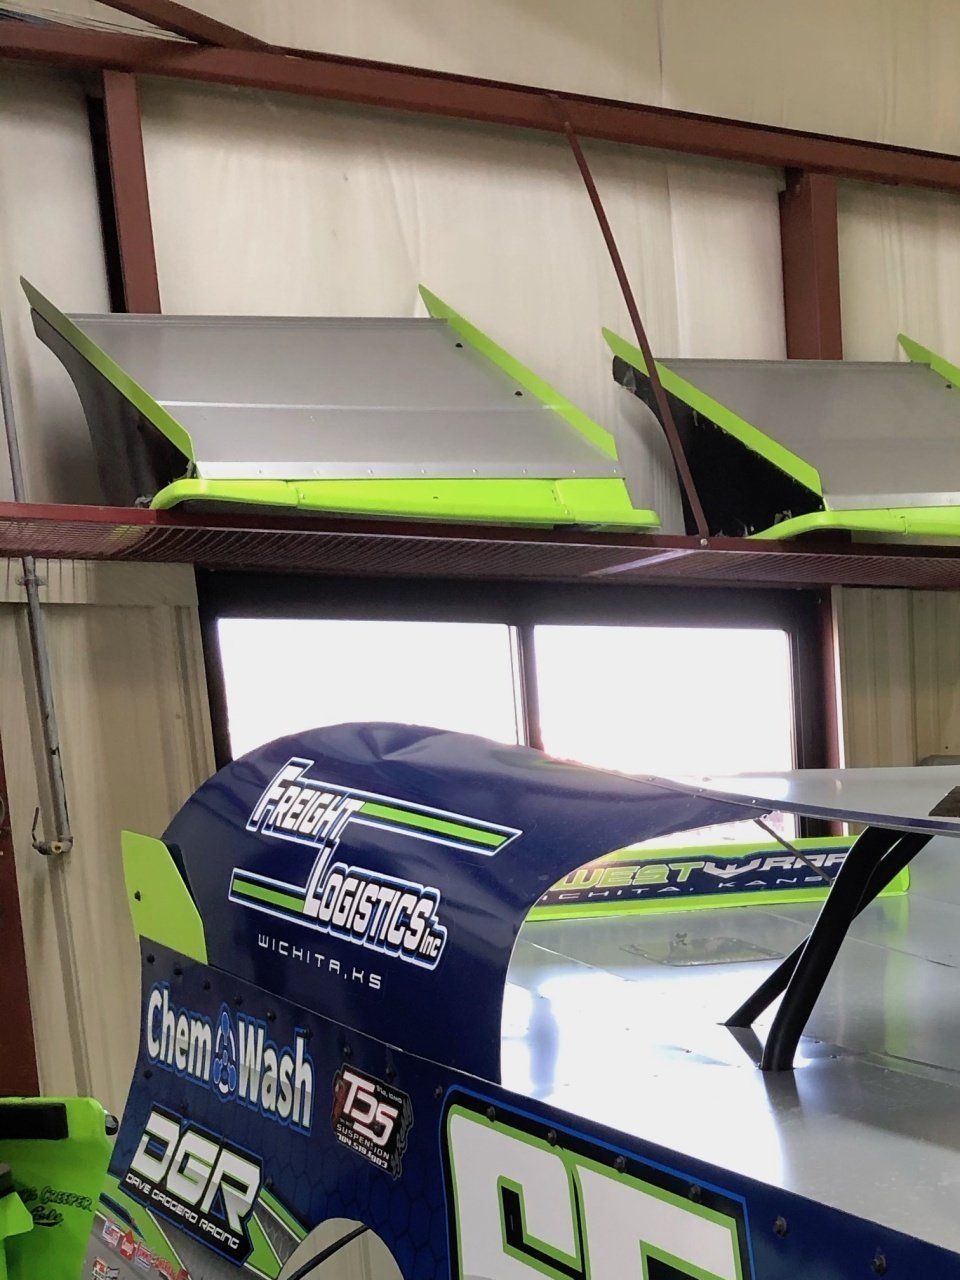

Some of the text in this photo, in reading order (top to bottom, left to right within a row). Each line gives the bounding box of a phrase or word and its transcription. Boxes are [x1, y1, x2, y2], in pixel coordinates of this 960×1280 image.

[252, 765, 366, 840] FREIGHT
[303, 847, 433, 951] LOGISTICS
[147, 988, 314, 1128] Chem Wash
[126, 1173, 151, 1195] DAVE
[199, 1218, 240, 1250] RACING
[130, 1110, 262, 1236] DGR
